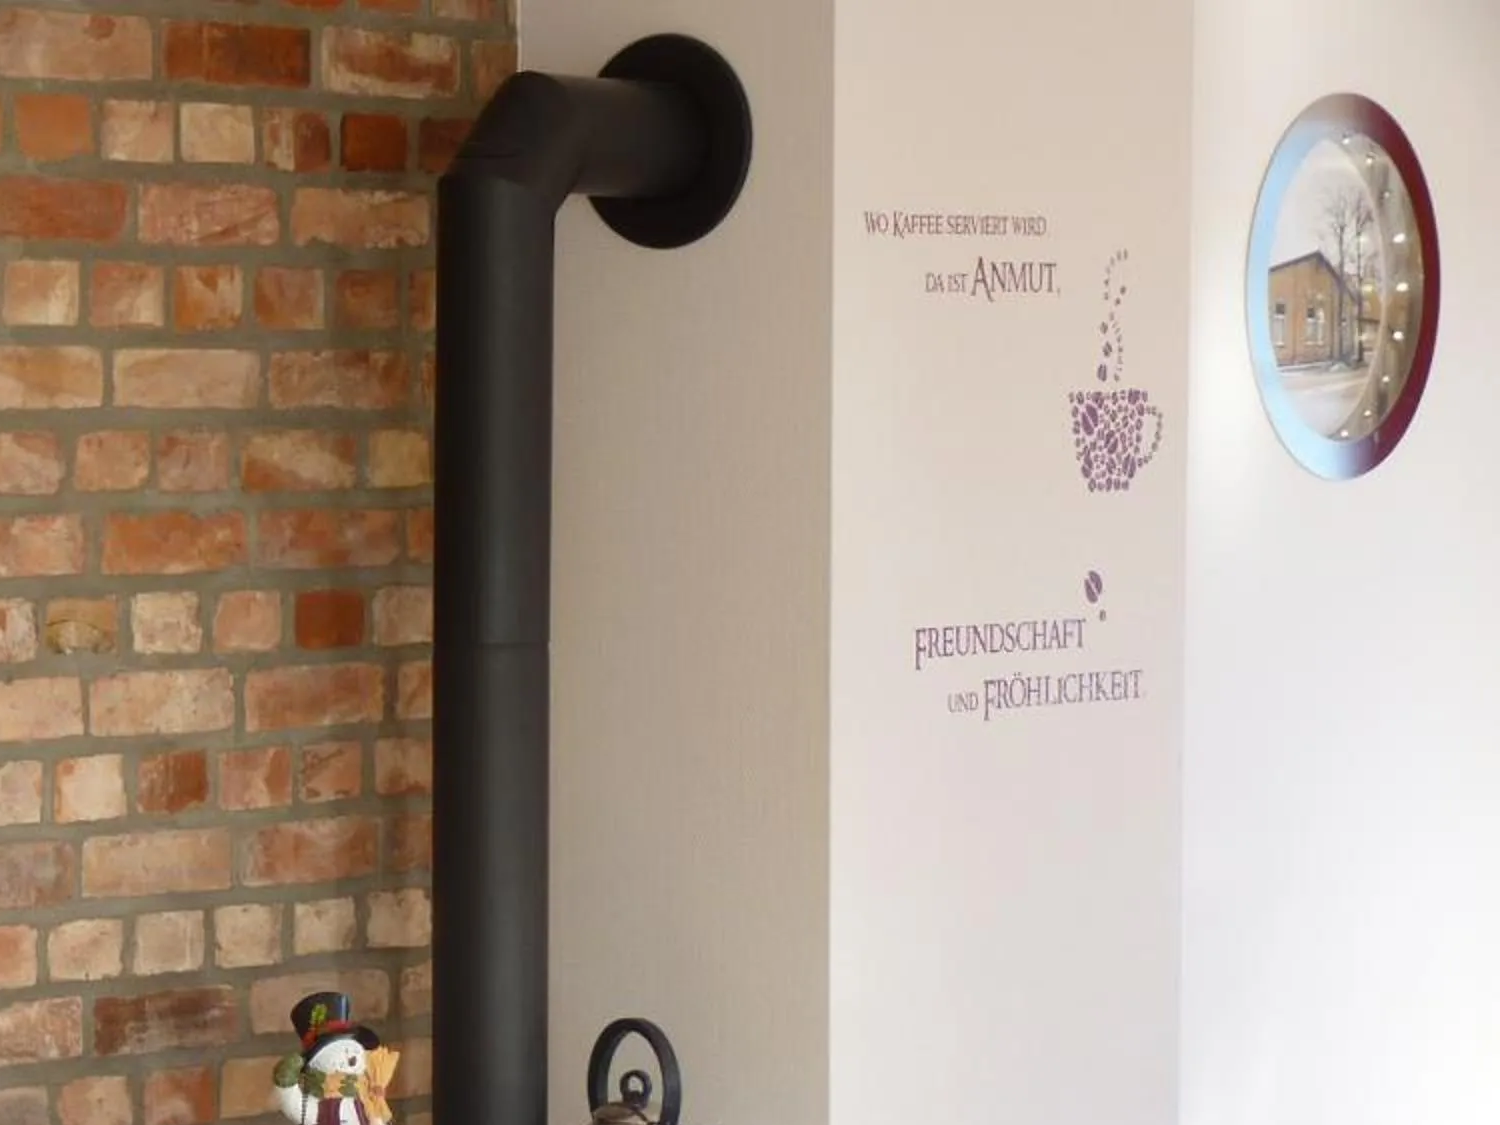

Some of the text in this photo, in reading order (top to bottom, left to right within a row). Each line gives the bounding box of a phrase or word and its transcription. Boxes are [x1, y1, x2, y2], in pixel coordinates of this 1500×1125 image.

[893, 211, 944, 239] KAFFEE
[946, 214, 1009, 236] SERVIERT
[1012, 215, 1047, 236] WIRD
[925, 273, 945, 293] DA
[947, 273, 969, 293] IST
[915, 618, 1086, 670] FREUNDSCHAFT
[947, 691, 979, 713] UND
